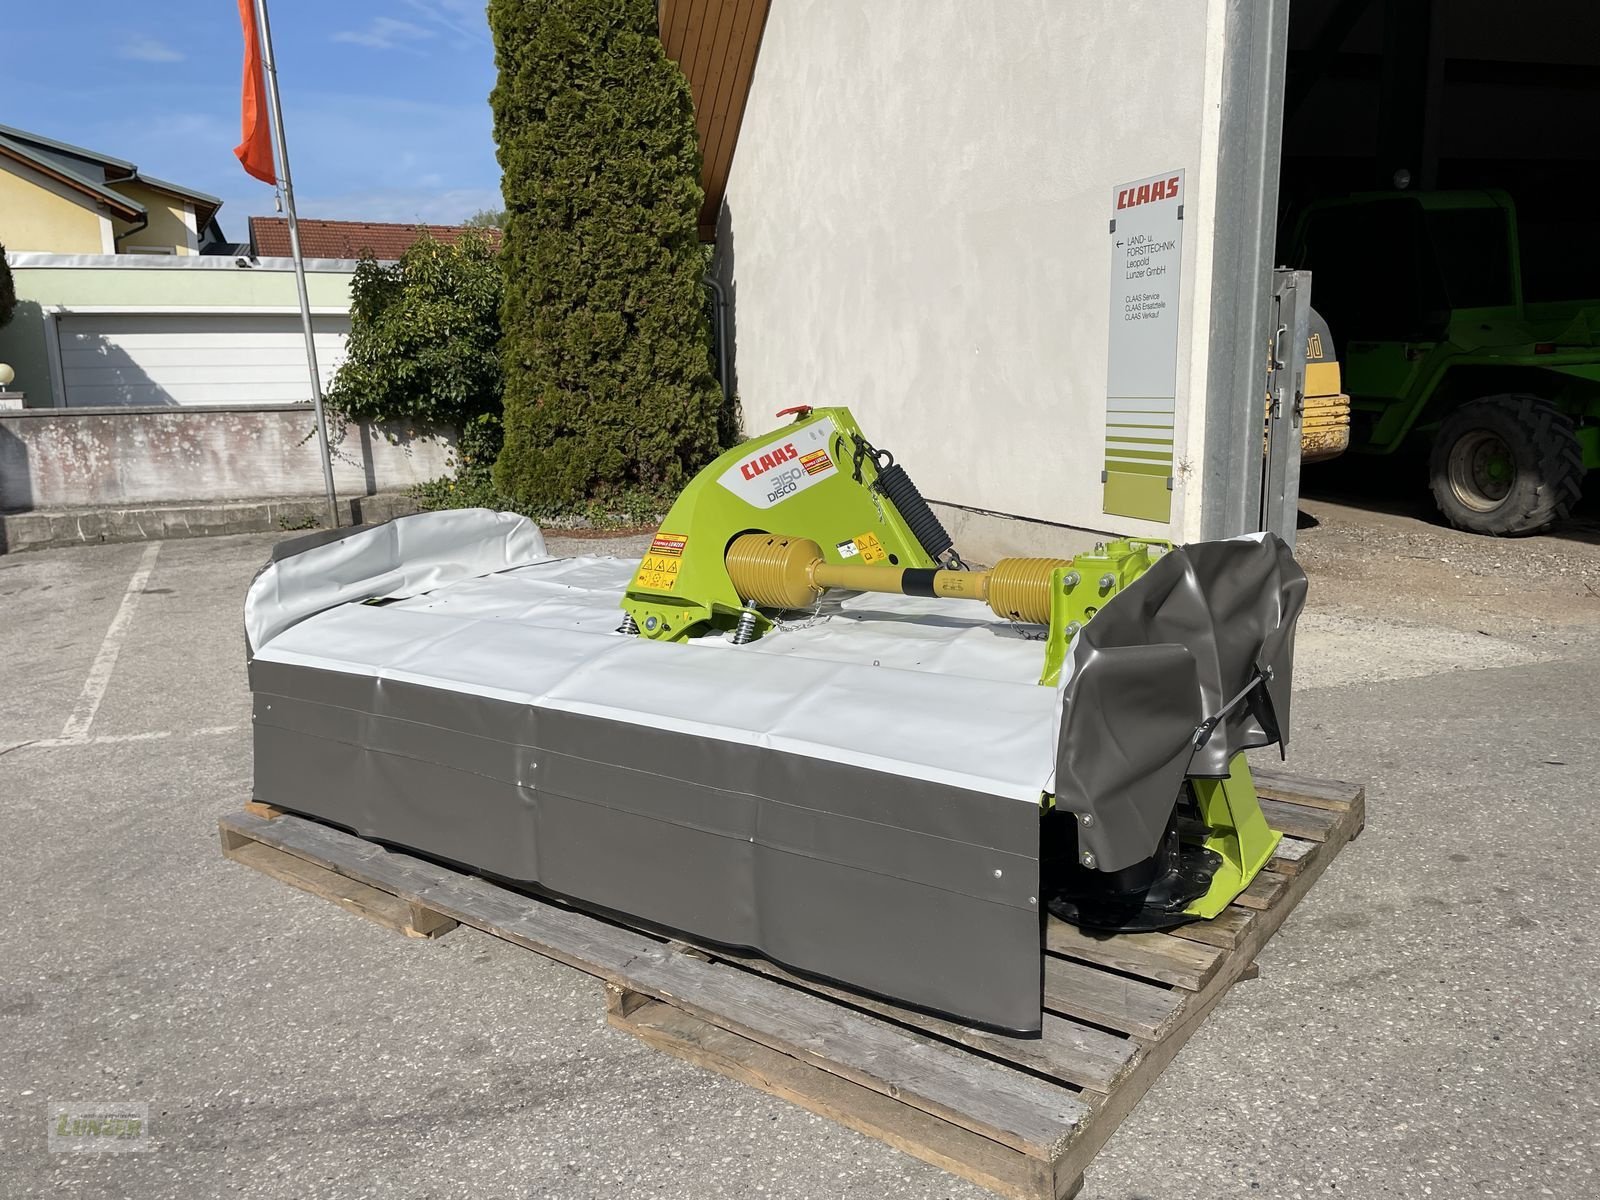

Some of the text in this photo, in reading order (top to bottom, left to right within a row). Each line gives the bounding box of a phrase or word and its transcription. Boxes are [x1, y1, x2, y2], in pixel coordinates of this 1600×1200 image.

[1117, 177, 1179, 210] CLAAS
[1127, 235, 1146, 246] LAND-
[1127, 240, 1175, 256] FORSTTECHNIK
[1126, 257, 1149, 269] Leopold
[1126, 265, 1166, 280] Lunzer GmbH
[1125, 293, 1160, 303] CLAAS Service
[1125, 303, 1142, 312] CLAAS
[1124, 310, 1160, 321] CLAAS Verkauf
[740, 443, 798, 481] CLAAS
[770, 467, 802, 490] 3150
[767, 481, 797, 503] DISCO
